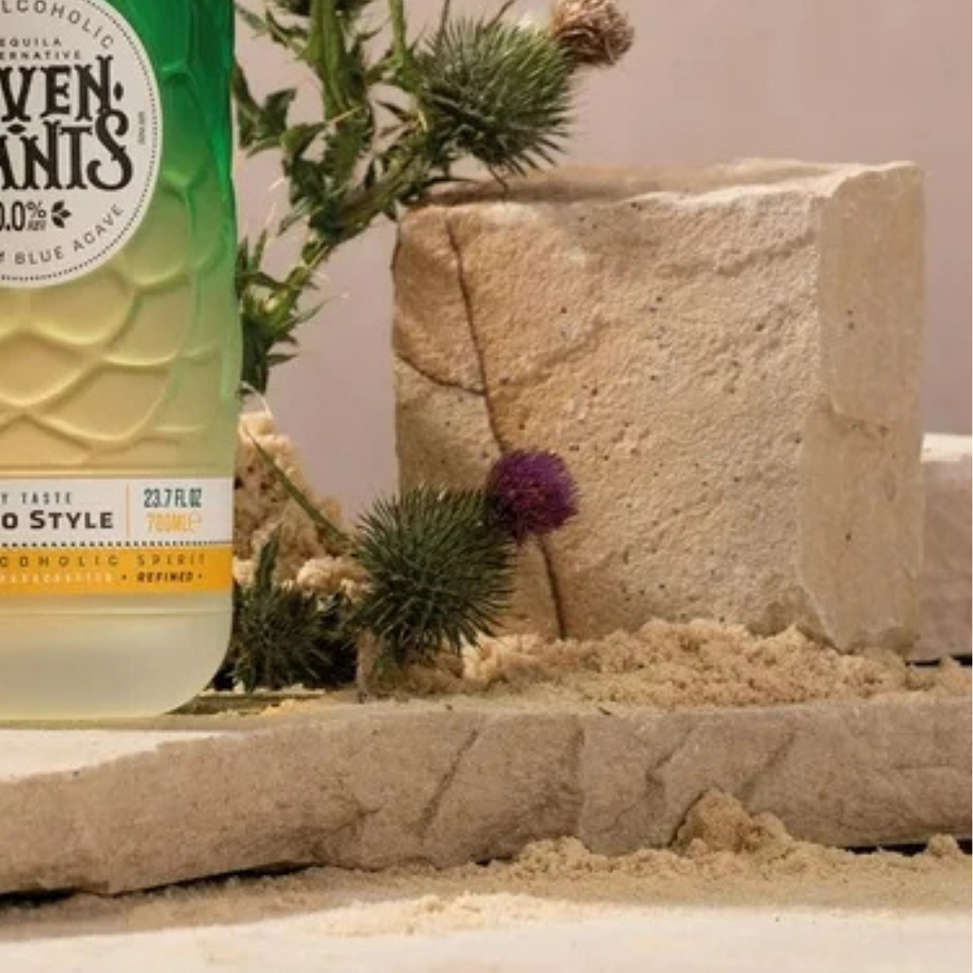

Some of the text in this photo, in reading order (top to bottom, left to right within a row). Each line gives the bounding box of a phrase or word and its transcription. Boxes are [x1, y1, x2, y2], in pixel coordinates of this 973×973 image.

[14, 246, 64, 265] BLUE
[73, 203, 124, 252] AGAVE
[21, 491, 72, 506] TASTE
[143, 487, 172, 508] 23.7
[30, 509, 114, 530] STYLE
[136, 553, 205, 566] SPIRIT
